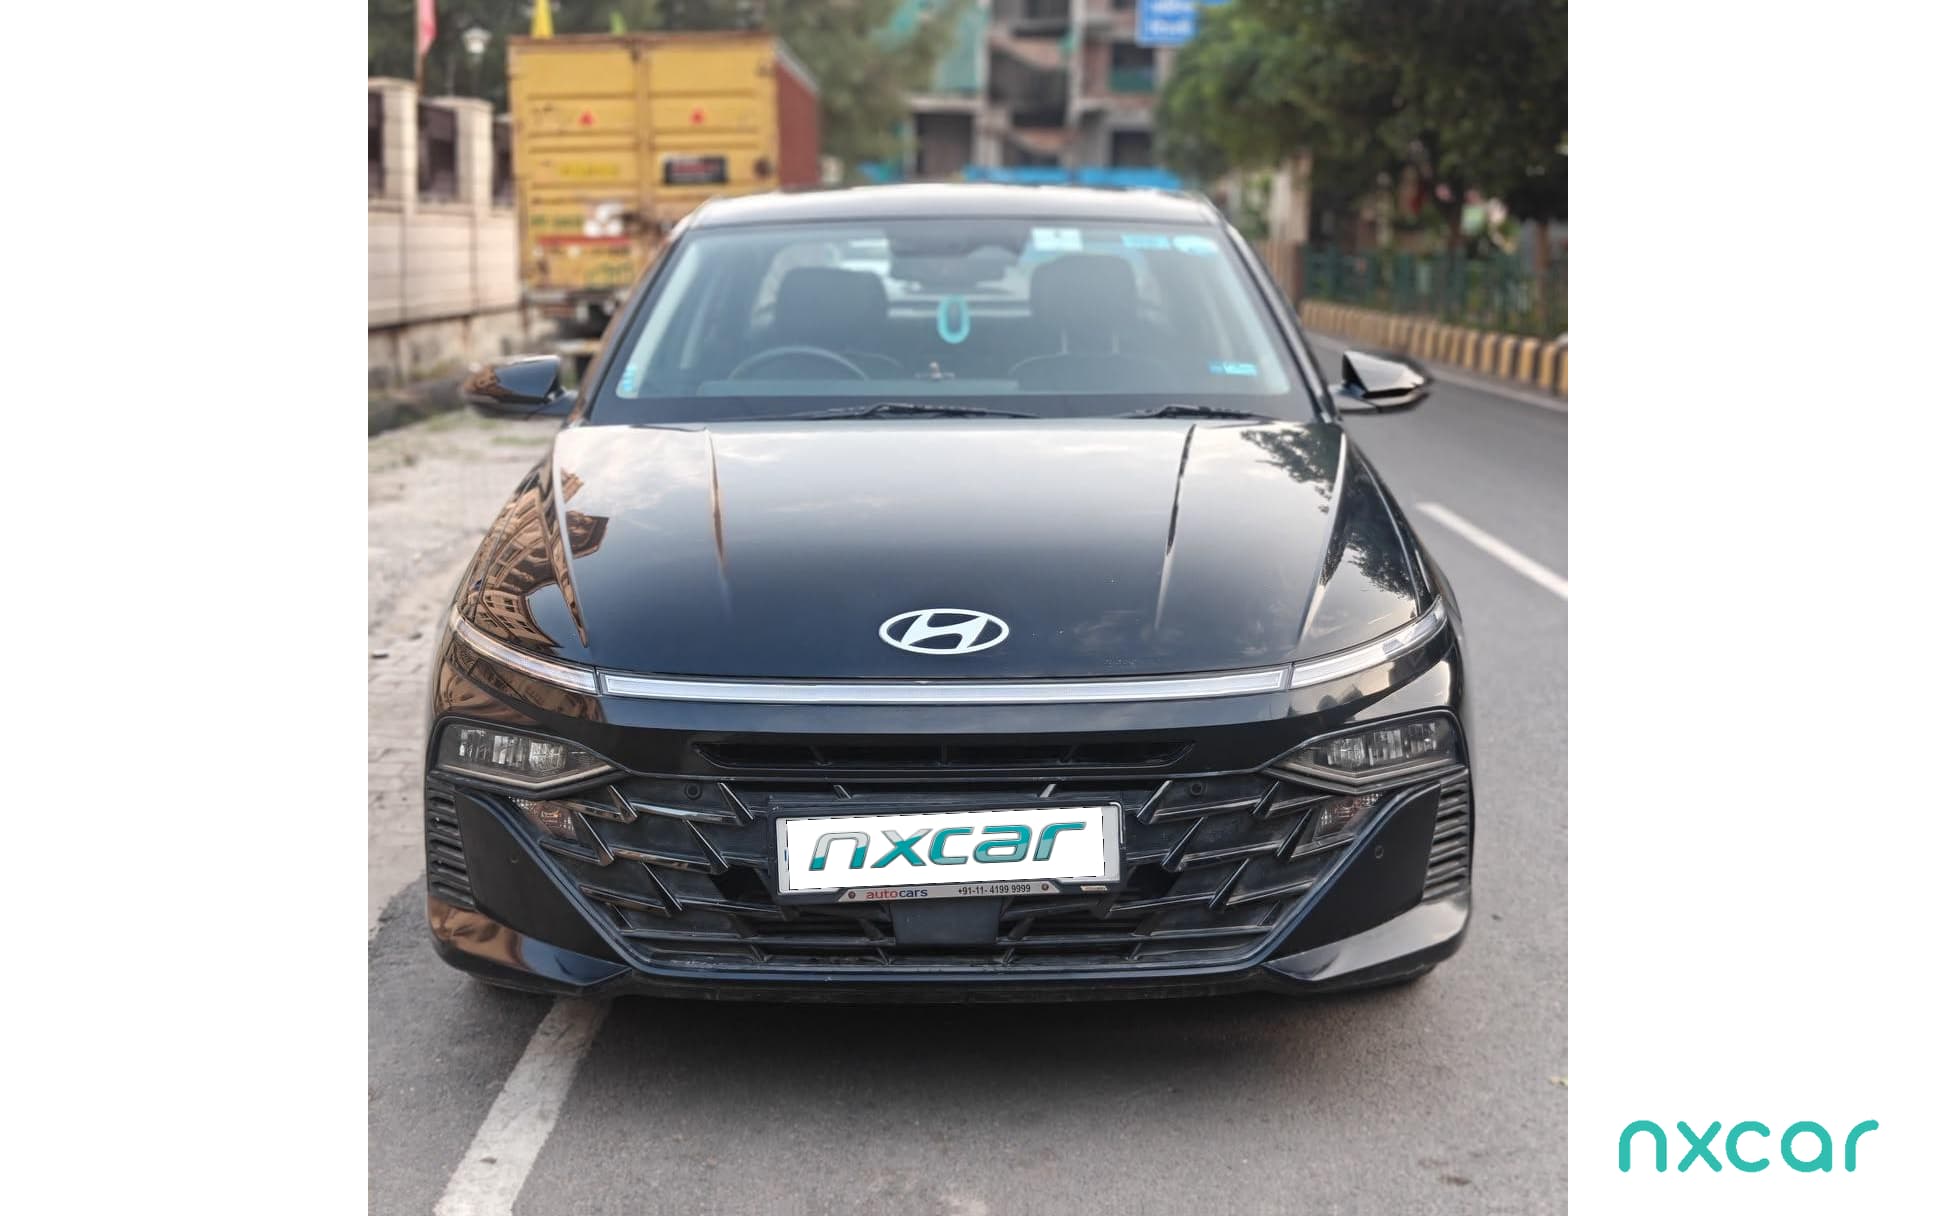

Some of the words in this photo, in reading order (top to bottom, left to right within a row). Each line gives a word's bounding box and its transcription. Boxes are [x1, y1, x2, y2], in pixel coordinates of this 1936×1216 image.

[865, 888, 928, 900] autocars
[989, 885, 1009, 894] 4199
[1011, 884, 1031, 893] 9999
